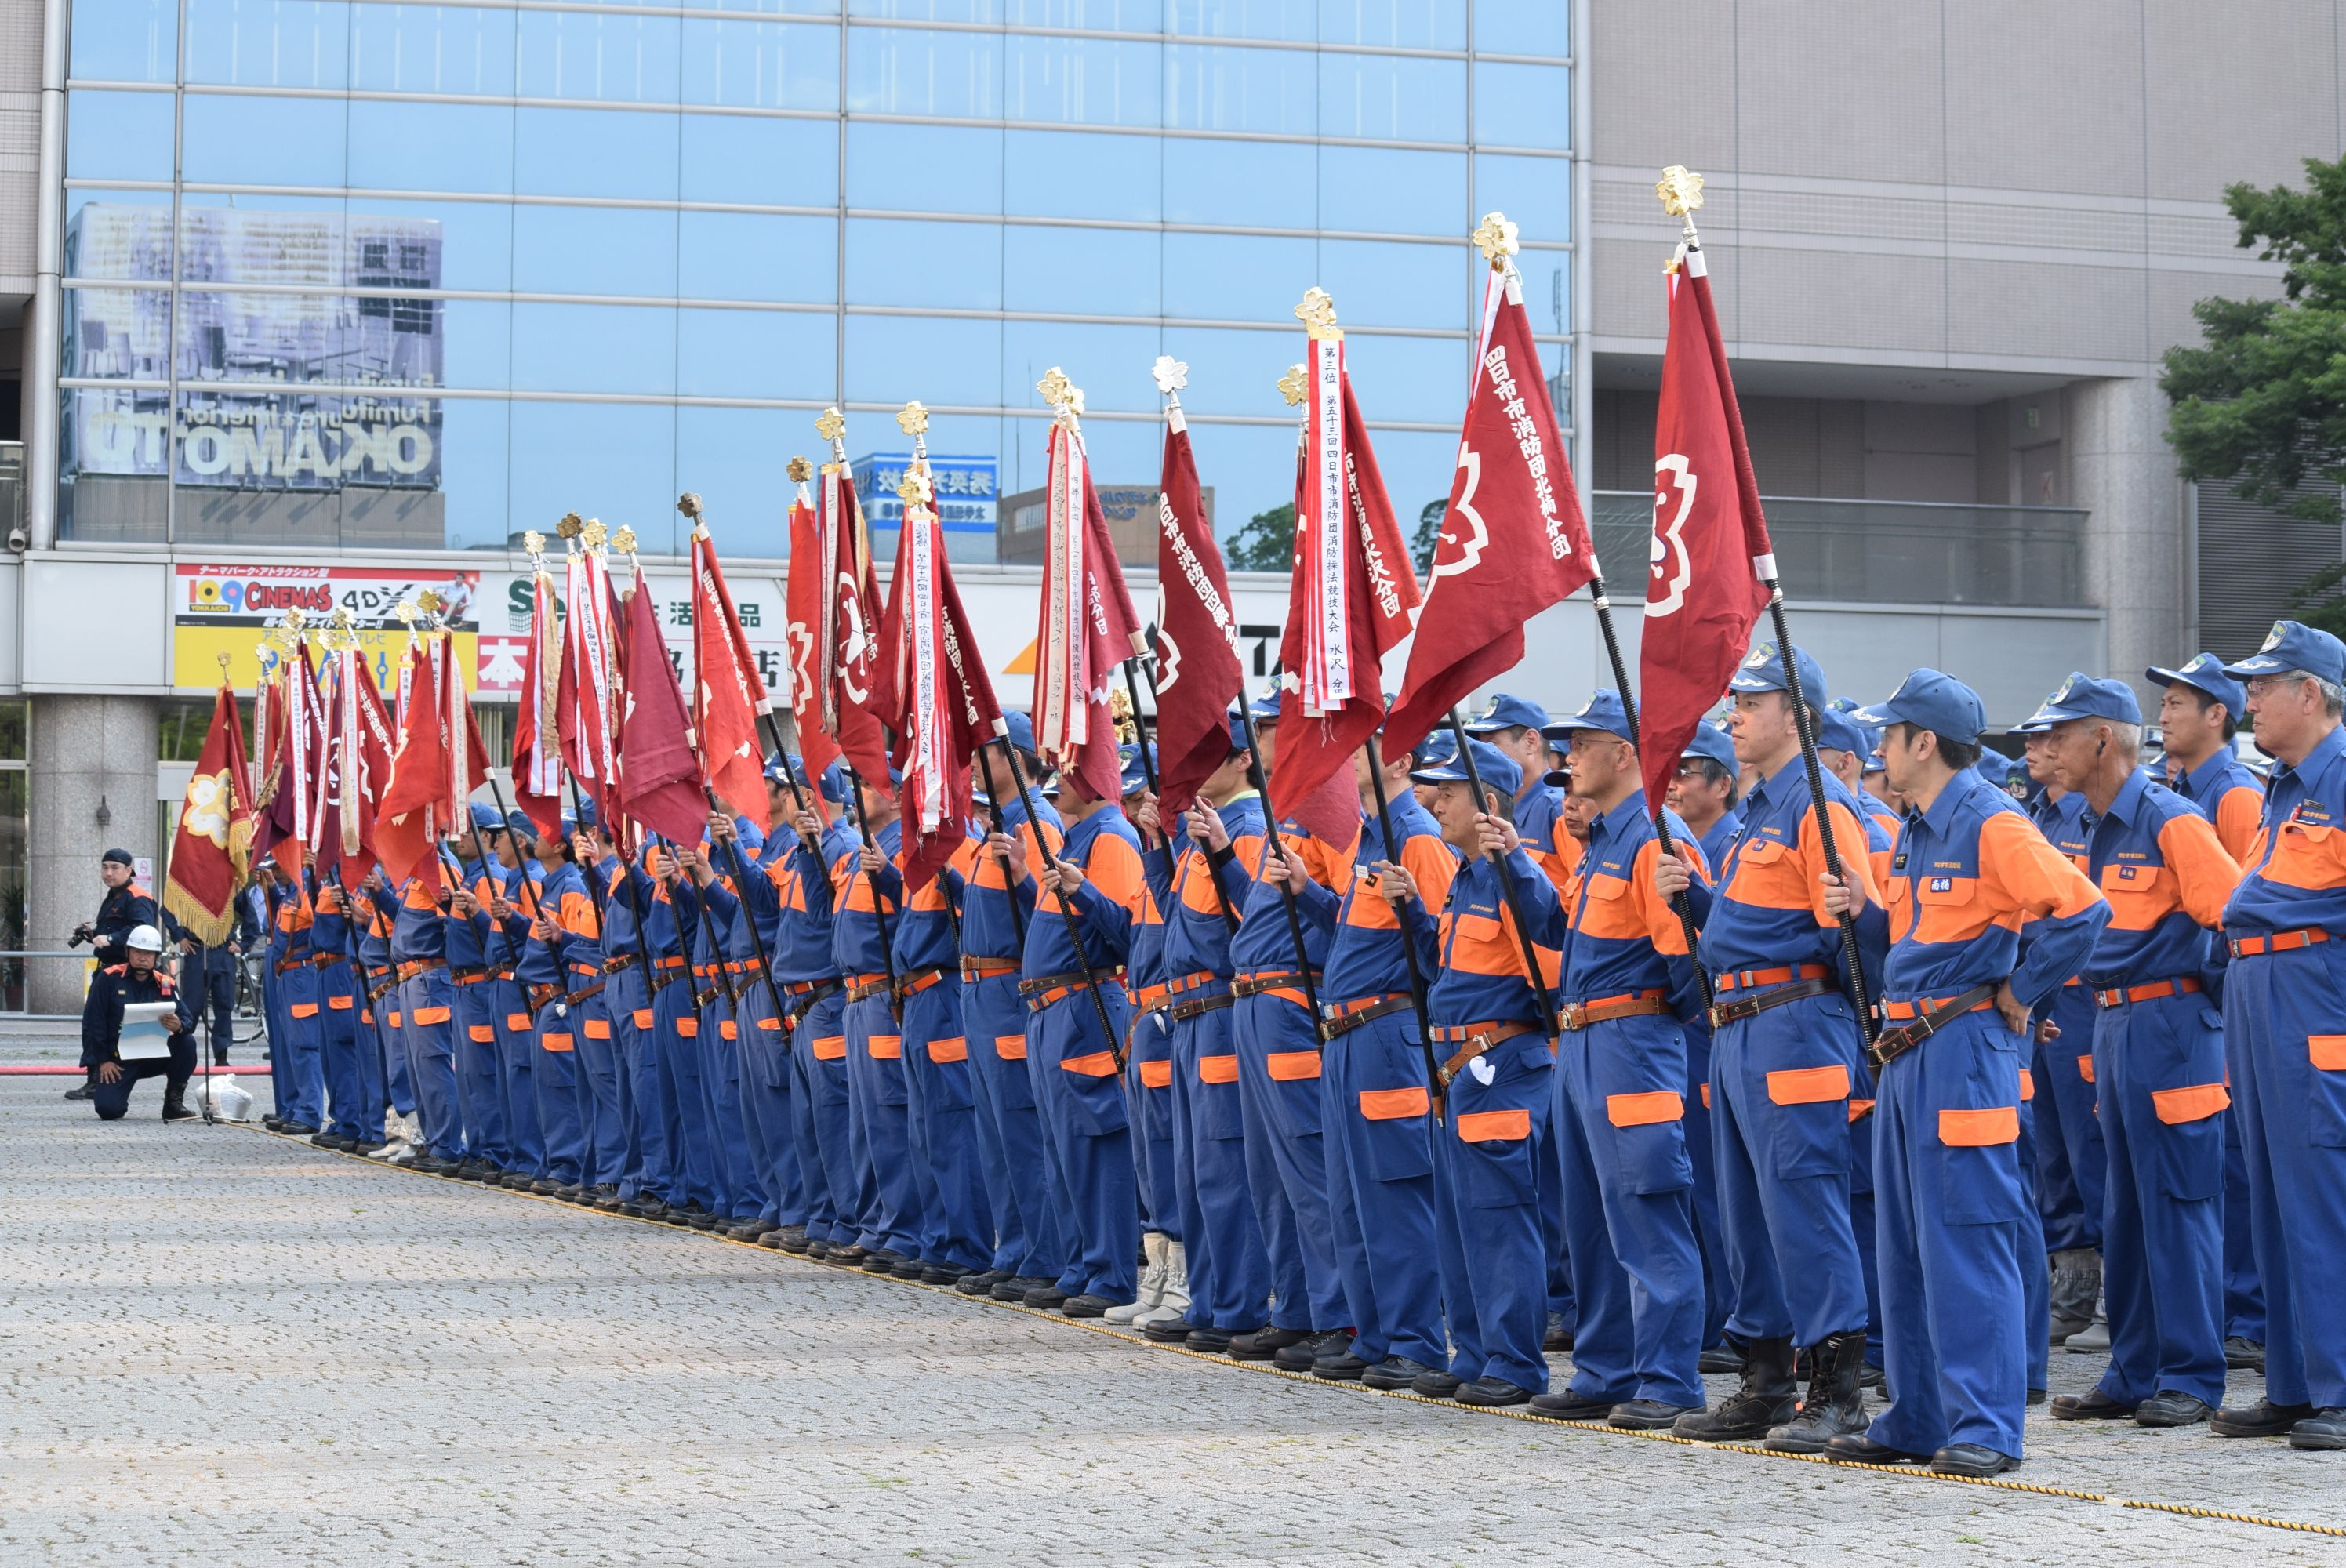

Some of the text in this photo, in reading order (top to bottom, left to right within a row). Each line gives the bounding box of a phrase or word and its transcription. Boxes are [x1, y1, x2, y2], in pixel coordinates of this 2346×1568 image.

[1324, 347, 1337, 384] 第三位
[189, 579, 244, 613] 109
[245, 581, 332, 612] CINEMAS
